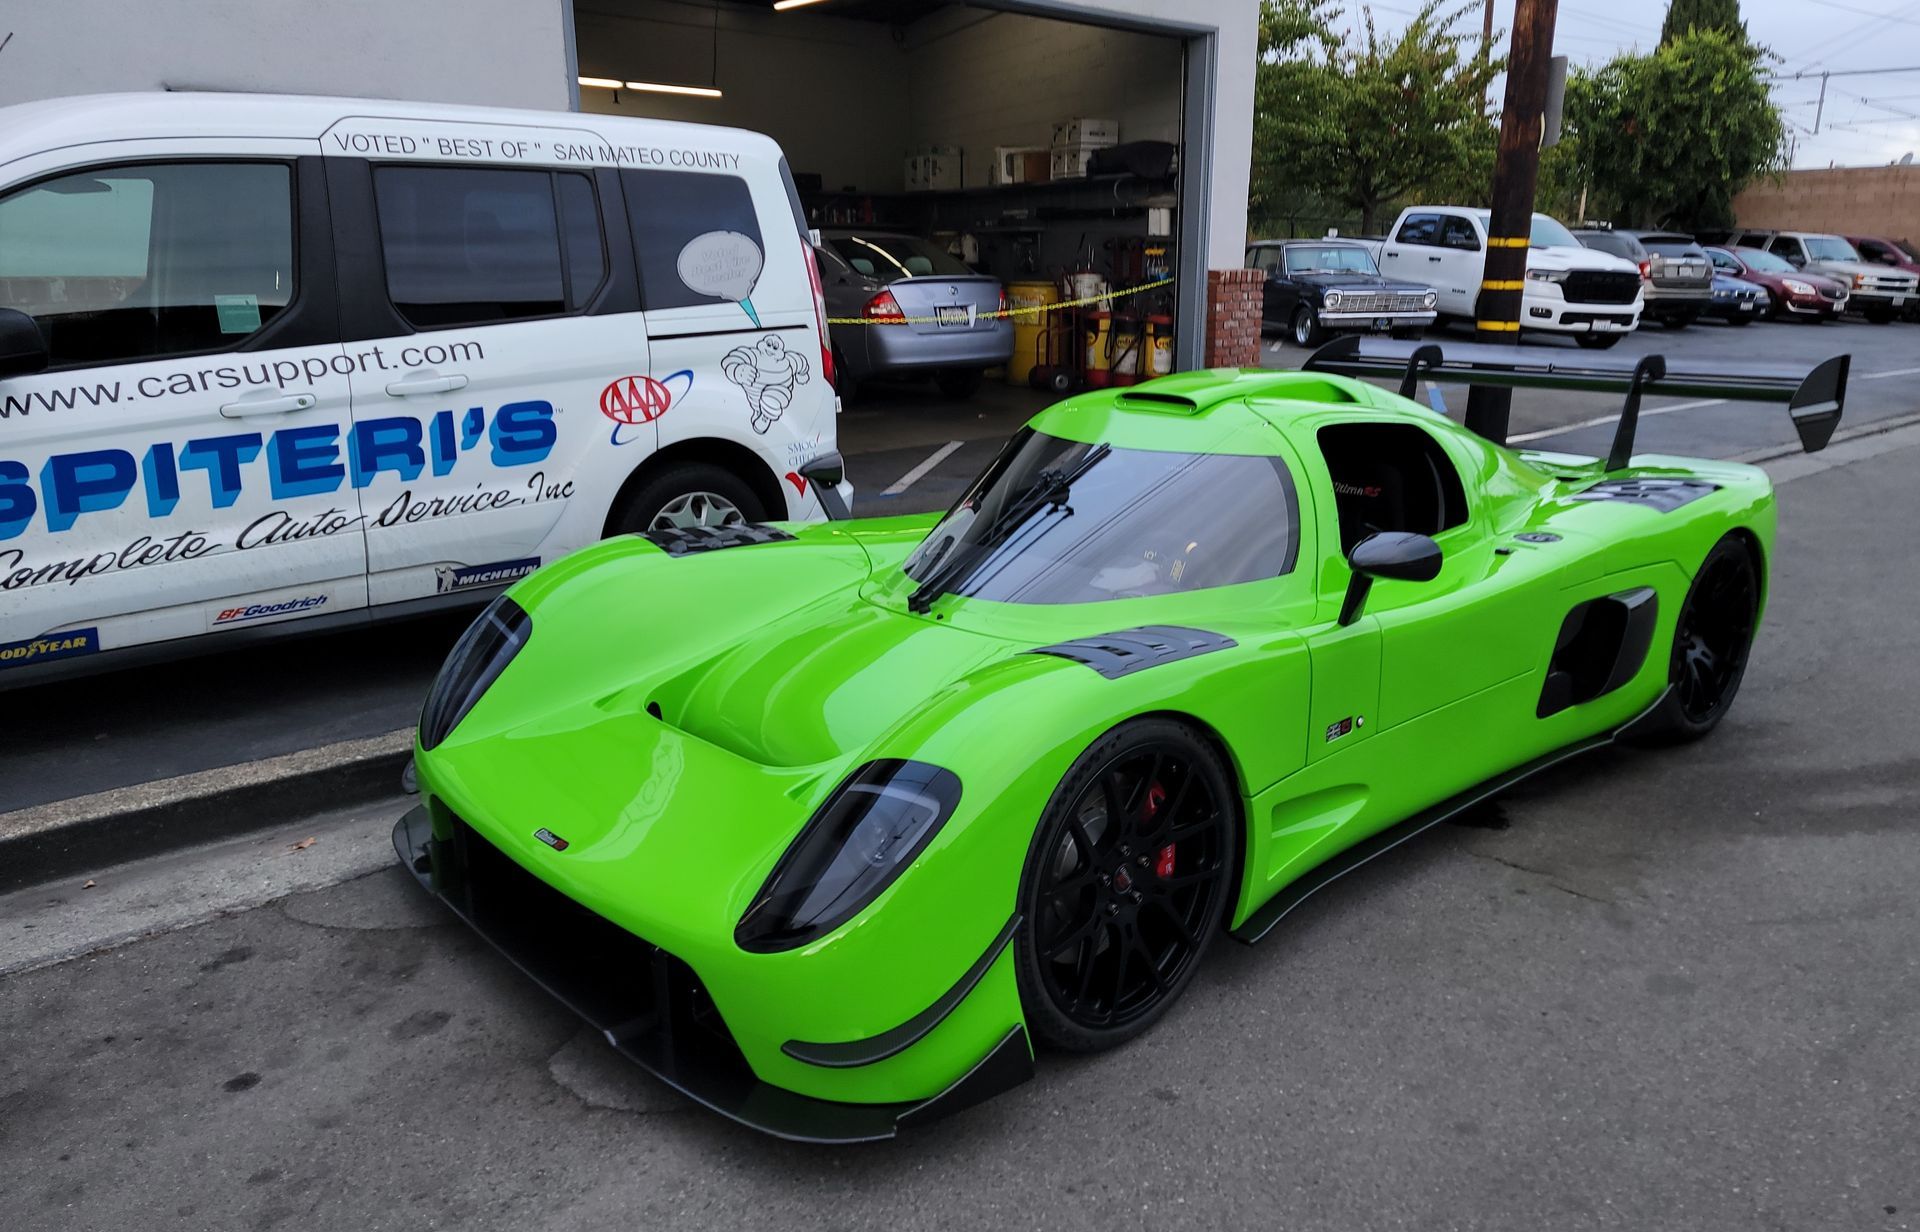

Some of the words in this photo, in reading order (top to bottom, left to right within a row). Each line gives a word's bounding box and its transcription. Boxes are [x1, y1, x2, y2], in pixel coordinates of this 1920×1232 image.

[334, 133, 416, 154] VOTED
[437, 138, 493, 157] BEST
[501, 141, 528, 158] OF
[554, 143, 594, 161] SAN
[598, 145, 665, 165] MATEO
[669, 150, 740, 170] COUNTY
[0, 337, 484, 419] www.carsupport.com
[610, 375, 667, 423] AAA
[788, 441, 817, 454] SMOG
[0, 531, 223, 590] Complete
[235, 508, 368, 550] Auto
[527, 471, 575, 502] Inc
[458, 564, 538, 586] MICHELIN
[216, 594, 328, 621] BFGoodrich
